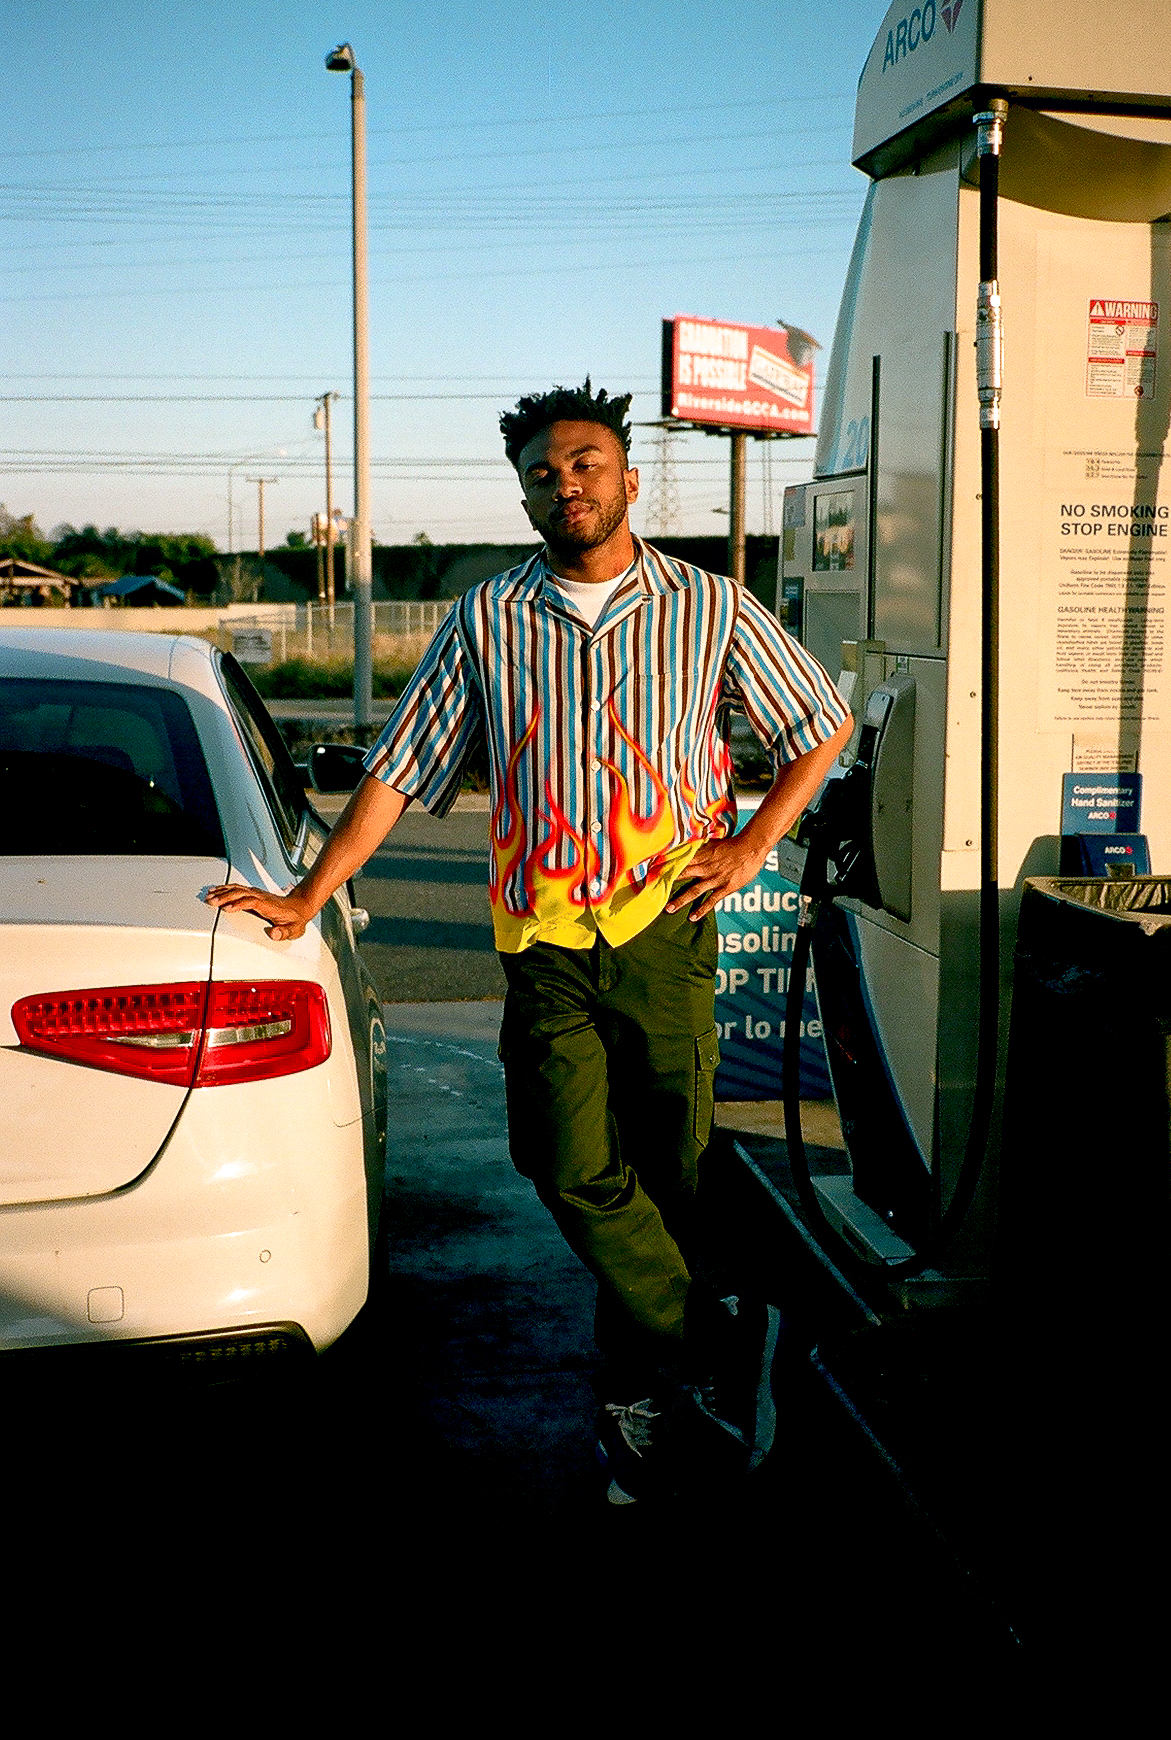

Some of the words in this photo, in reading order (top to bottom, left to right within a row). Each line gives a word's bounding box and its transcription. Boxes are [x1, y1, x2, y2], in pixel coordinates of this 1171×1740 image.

[882, 0, 936, 73] ARCO
[1104, 302, 1157, 320] WARNING
[1060, 504, 1086, 517] NO
[1090, 504, 1169, 519] SMOKING
[1060, 522, 1103, 536] STOP
[1107, 523, 1168, 537] ENGINE
[1073, 785, 1133, 796] Complimentary
[1071, 797, 1095, 807] Hand
[1096, 798, 1134, 808] Sanitizer
[1088, 811, 1109, 820] ARCO
[1104, 846, 1126, 854] ARCO
[745, 1015, 771, 1039] lo
